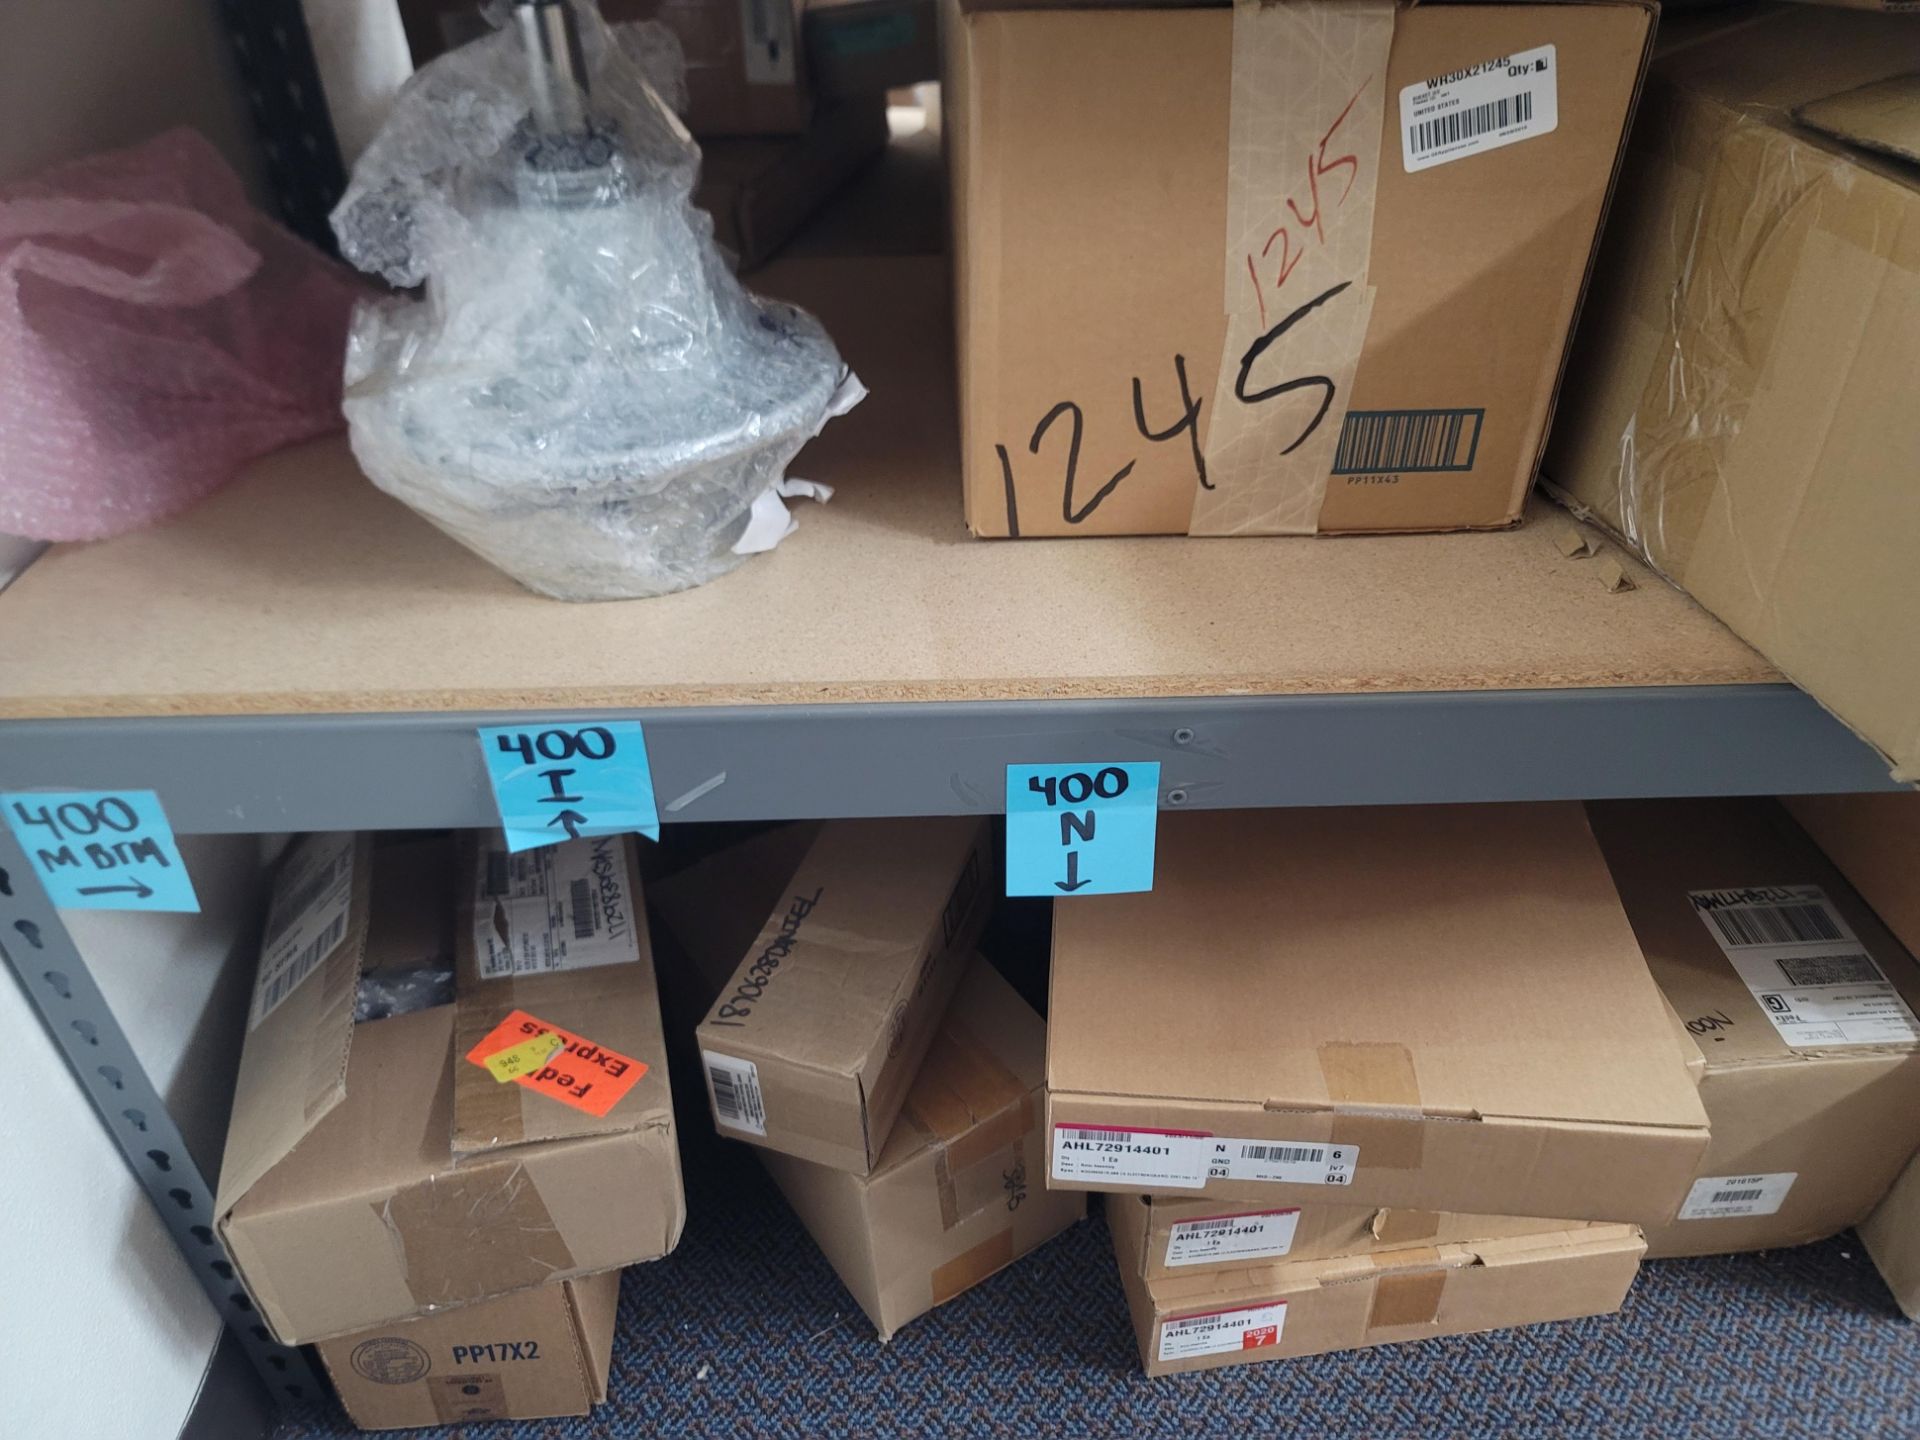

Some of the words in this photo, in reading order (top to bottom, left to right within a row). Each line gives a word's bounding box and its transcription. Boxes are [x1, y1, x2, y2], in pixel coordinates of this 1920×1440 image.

[1248, 74, 1373, 330] 1245
[995, 281, 1352, 537] 1245
[499, 726, 617, 764] 400
[1029, 766, 1129, 806] 400
[13, 797, 140, 841] 400
[1060, 810, 1095, 846] N
[37, 847, 79, 873] M
[88, 836, 171, 871] BTM
[1767, 997, 1784, 1011] G
[1062, 1141, 1170, 1156] AHL72914401
[1215, 1144, 1226, 1152] N
[1333, 1150, 1342, 1159] 6
[1209, 1168, 1228, 1177] 04
[1327, 1174, 1345, 1183] 04
[1176, 1225, 1265, 1242] AHL72914401
[1165, 1318, 1252, 1338] AHL72914401
[1246, 1326, 1275, 1338] 2020
[1255, 1335, 1268, 1346] 7
[452, 1341, 541, 1364] PP17X2
